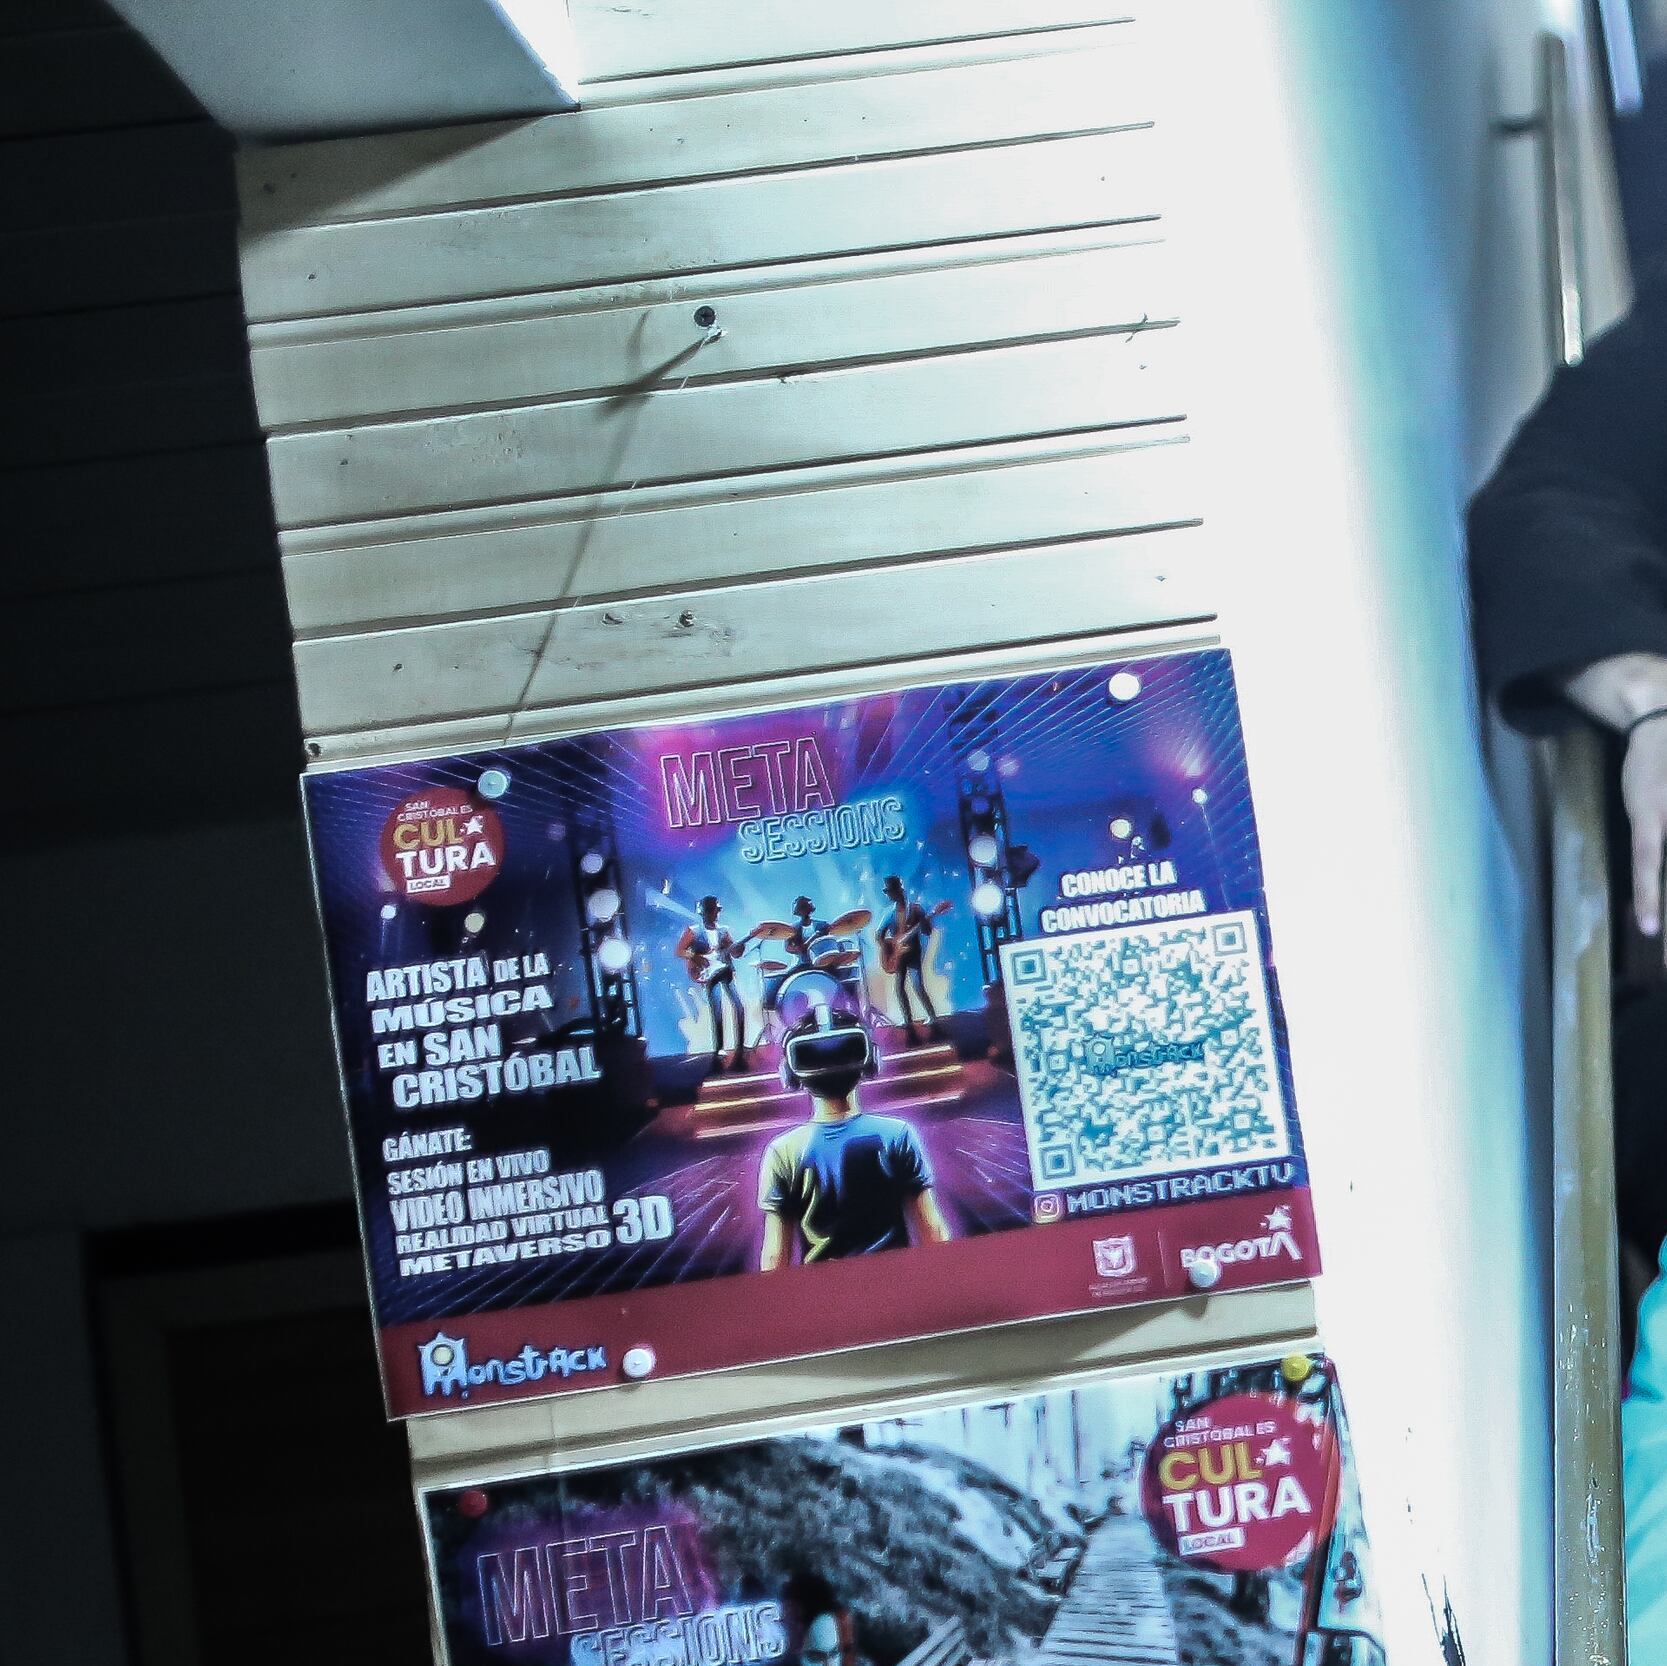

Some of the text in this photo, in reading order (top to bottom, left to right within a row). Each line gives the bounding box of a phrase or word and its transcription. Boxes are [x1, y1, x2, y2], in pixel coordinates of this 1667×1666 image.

[660, 737, 834, 828] META
[393, 818, 464, 849] CUL
[739, 797, 905, 863] SESSIONS
[396, 841, 496, 878] TURA
[1061, 860, 1177, 899] CONOCE LA
[410, 879, 447, 891] LOCAL
[1040, 890, 1207, 934] CONVOCATORIA
[366, 952, 552, 1002] ARTISTA DE LA
[371, 984, 553, 1034] MÚSICA
[377, 1024, 502, 1069] EN SAN
[392, 1046, 602, 1108] CRISTÓBAL
[387, 1149, 551, 1196] SESIÓN EN VIVO
[390, 1169, 605, 1231] VIDEO INMERSIVO
[612, 1195, 674, 1245] 3D
[396, 1205, 609, 1253] REALIDAD VIRTUAL
[400, 1229, 613, 1277] METAVERSO
[1175, 1416, 1210, 1432] SAN
[1158, 1441, 1263, 1490] CUL
[1162, 1475, 1312, 1532] TURA
[1183, 1534, 1236, 1551] LOCAL
[477, 1525, 693, 1646] META
